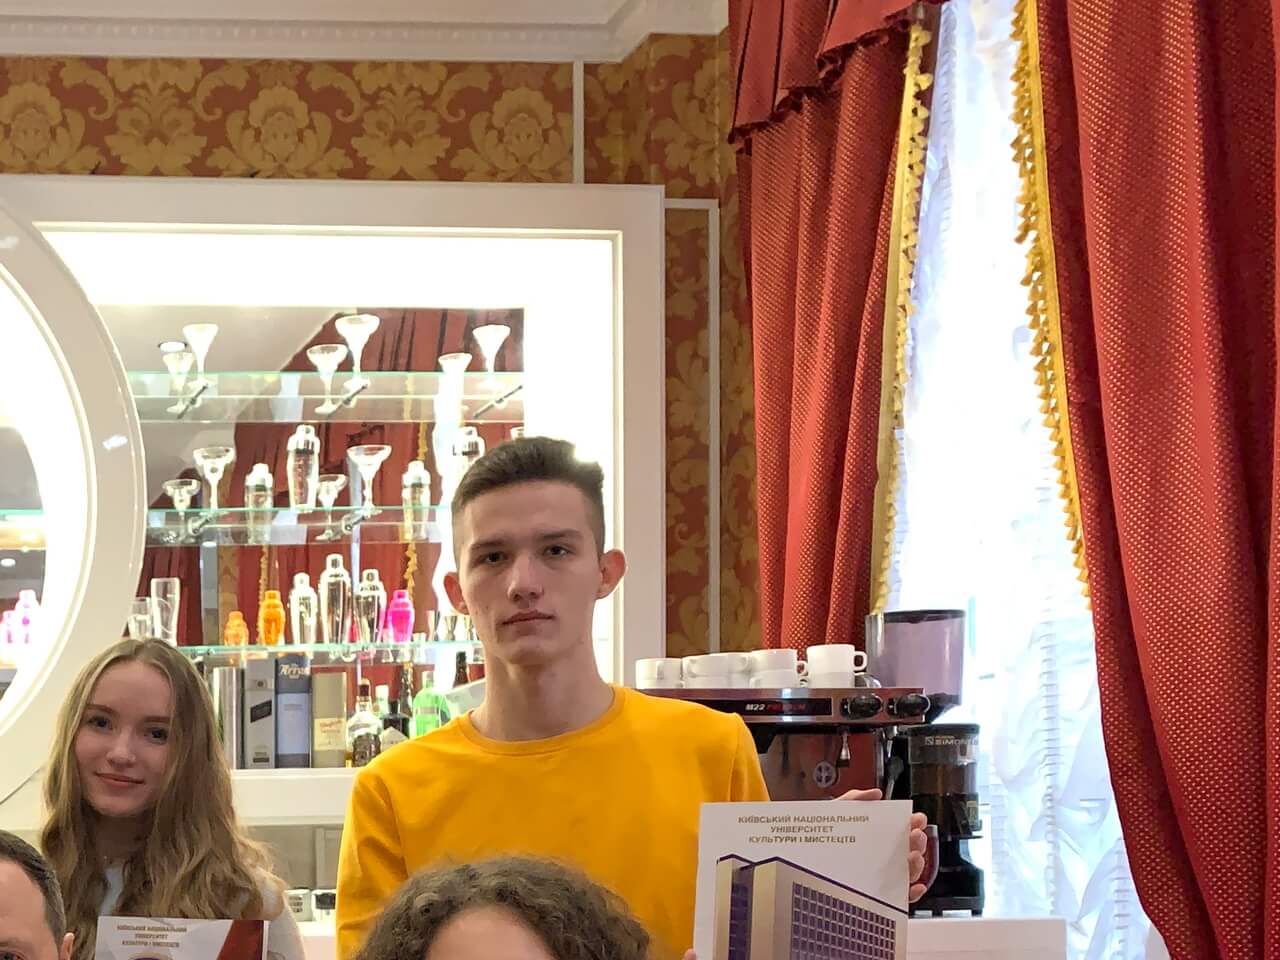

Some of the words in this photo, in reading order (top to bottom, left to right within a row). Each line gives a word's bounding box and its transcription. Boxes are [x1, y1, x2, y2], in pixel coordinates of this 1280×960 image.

[738, 814, 791, 824] КИЇВСЬКИЙ
[793, 814, 870, 824] НАЦІОНАЛЬНИЙ
[770, 825, 835, 833] УНІВЕРСИТЕТ
[748, 835, 797, 844] КУЛЬТУРИ
[804, 835, 856, 844] МИСТЕЦТВ
